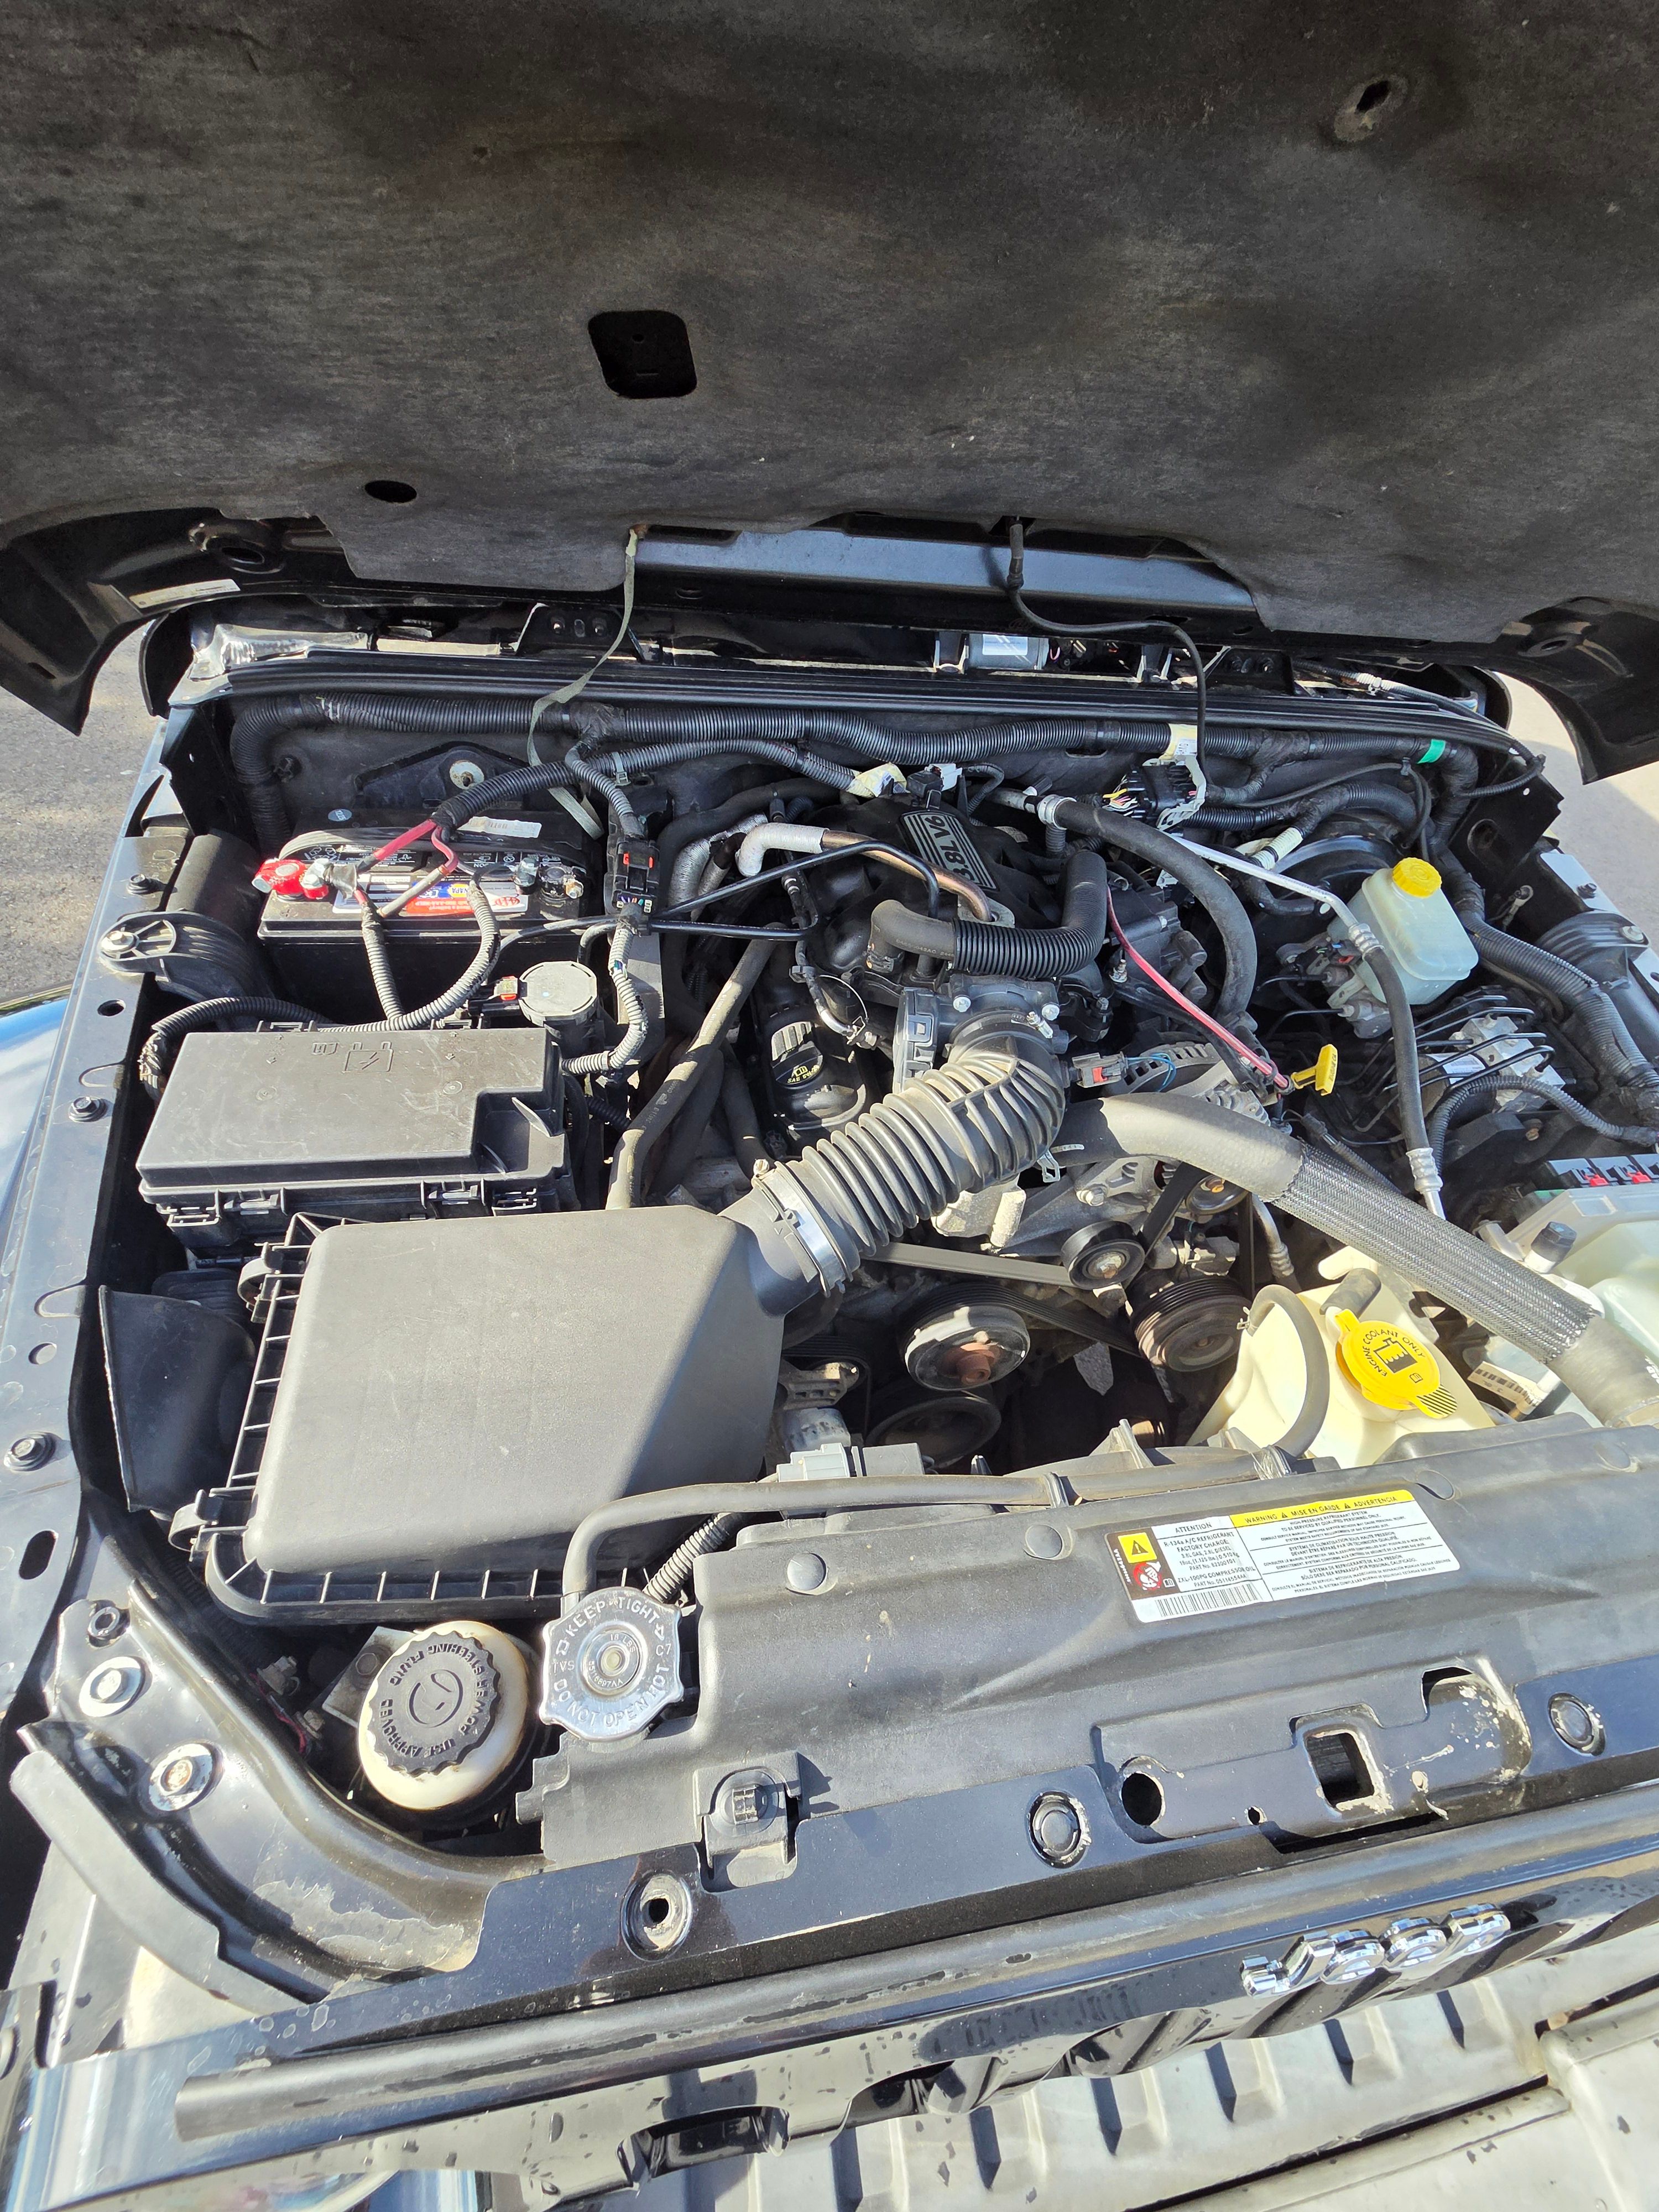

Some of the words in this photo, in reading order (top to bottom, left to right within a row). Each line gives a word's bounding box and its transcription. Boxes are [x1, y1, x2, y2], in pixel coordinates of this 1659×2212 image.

[925, 816, 951, 838] V6
[940, 840, 975, 881] 3.8L
[1363, 1329, 1398, 1344] COOLANT
[1402, 1337, 1425, 1358] ONLY
[1363, 1346, 1387, 1376] ENGINE
[1354, 1496, 1397, 1507] ADVERTENCIA
[1176, 1523, 1212, 1533] ATTENTION
[1245, 1514, 1277, 1523] WARNING
[1177, 1544, 1203, 1552] FACTORY
[1204, 1539, 1229, 1548] CHARGE
[1197, 1532, 1234, 1541] REFRIGERANT
[1208, 1567, 1245, 1578] COMPRESSOR
[566, 1601, 606, 1637] KEEP
[618, 1597, 660, 1624] TIGHT
[623, 1636, 636, 1652] LBS
[656, 1644, 671, 1656] C7
[389, 1651, 425, 1686] FLUID
[427, 1643, 484, 1676] STEERING
[553, 1660, 575, 1673] TVS
[554, 1678, 571, 1702] DO
[567, 1702, 600, 1726] NOT
[603, 1696, 648, 1726] OPEN
[646, 1663, 670, 1699] HOT
[458, 1679, 488, 1736] POWER
[380, 1699, 423, 1757] APPROVED
[424, 1738, 456, 1757] USE
